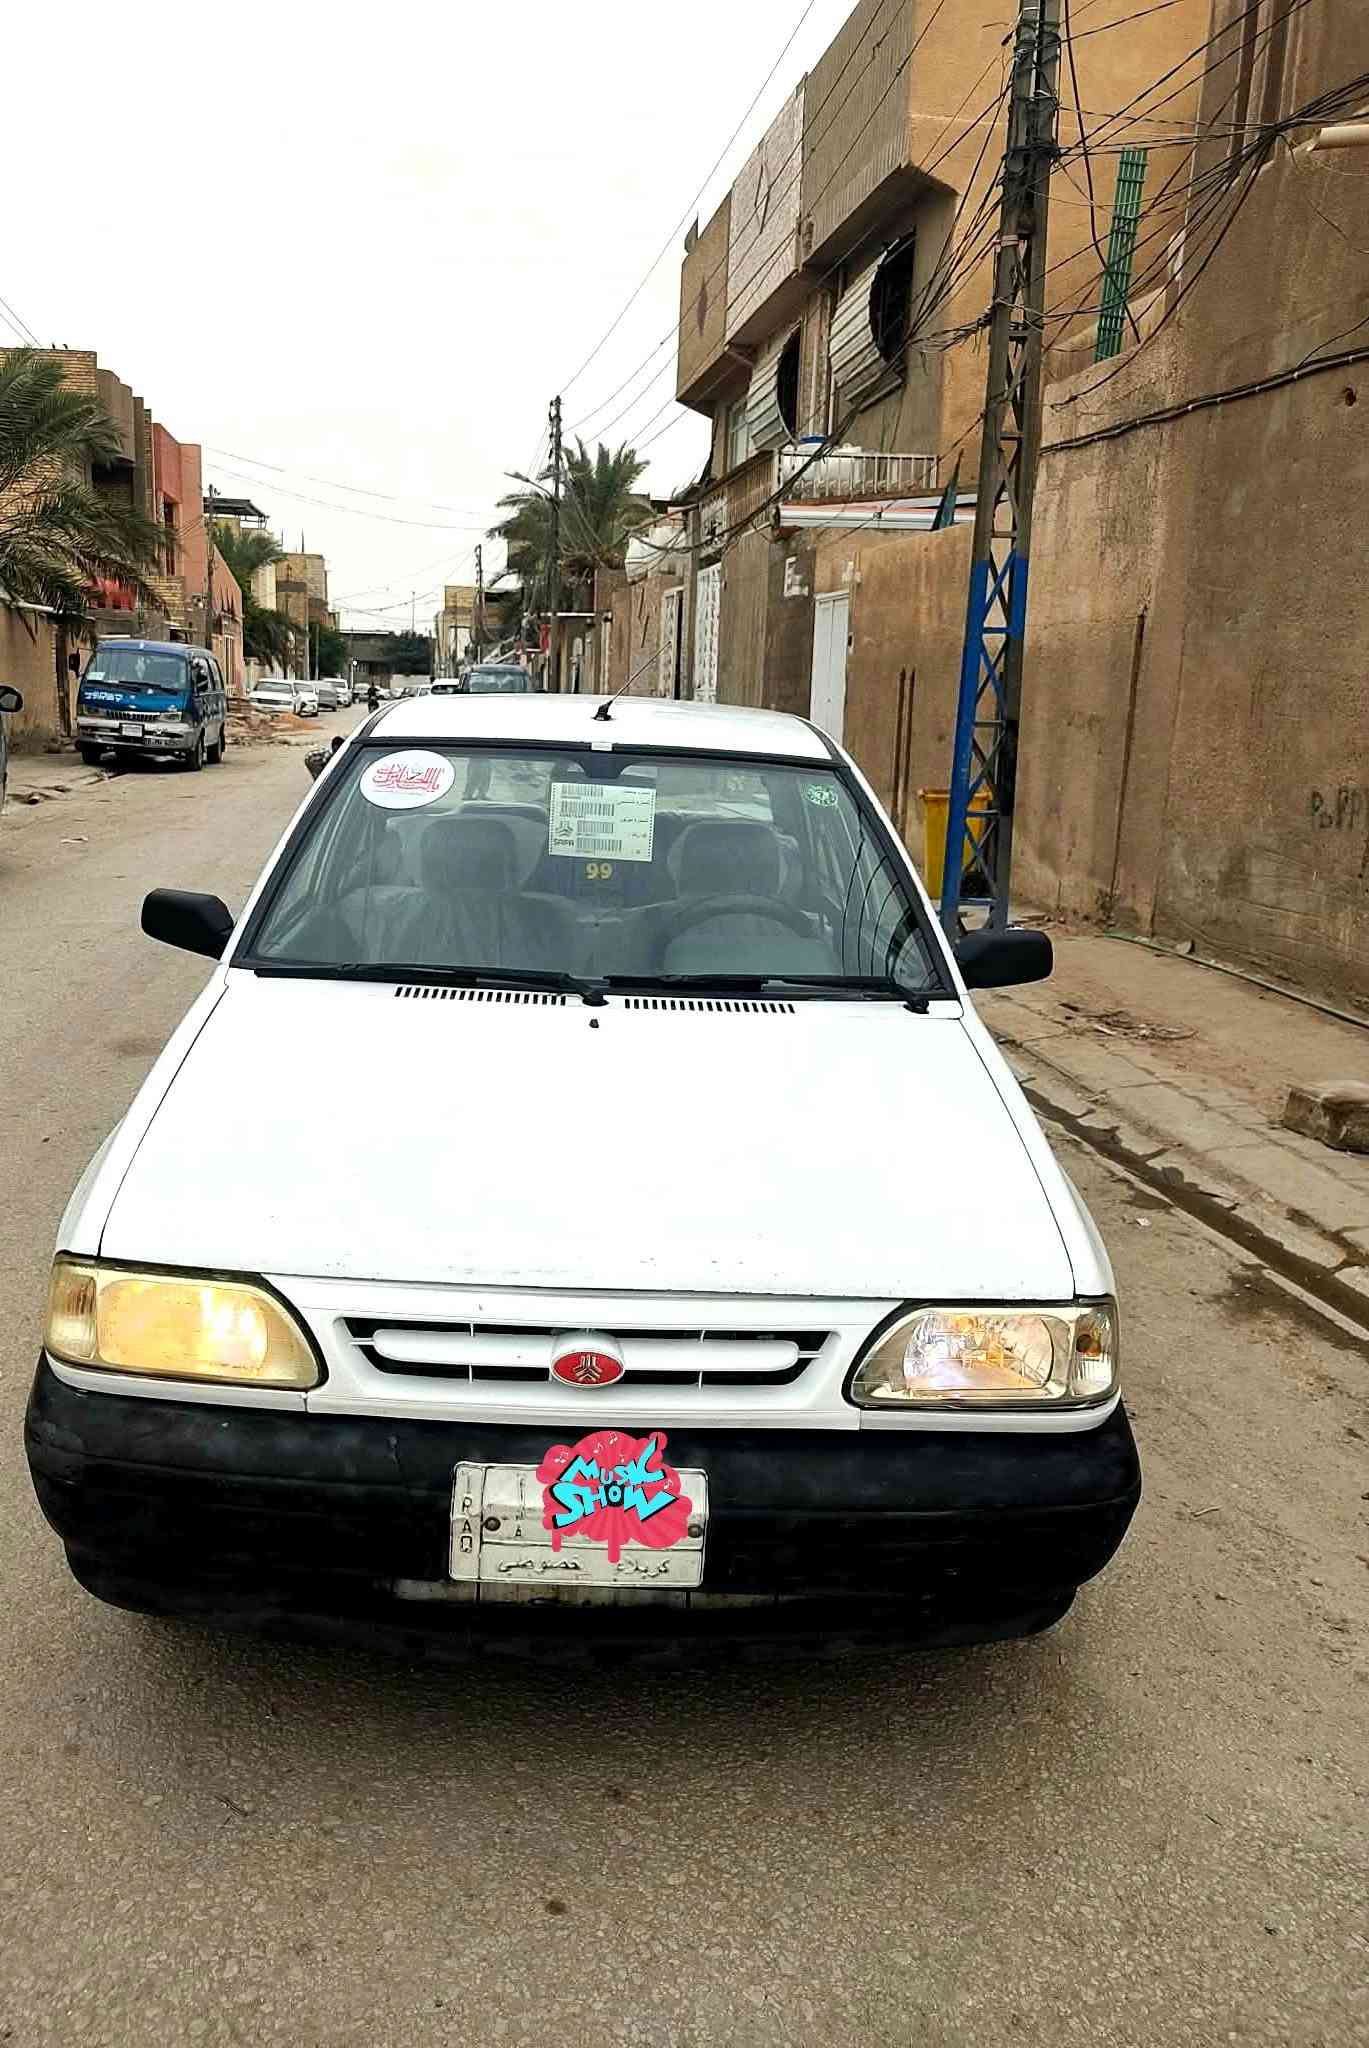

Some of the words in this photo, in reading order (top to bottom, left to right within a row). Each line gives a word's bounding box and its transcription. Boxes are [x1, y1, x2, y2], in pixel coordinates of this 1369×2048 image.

[585, 862, 613, 880] 99
[498, 1553, 583, 1577] خصوصي
[616, 1555, 671, 1578] كربلاء
